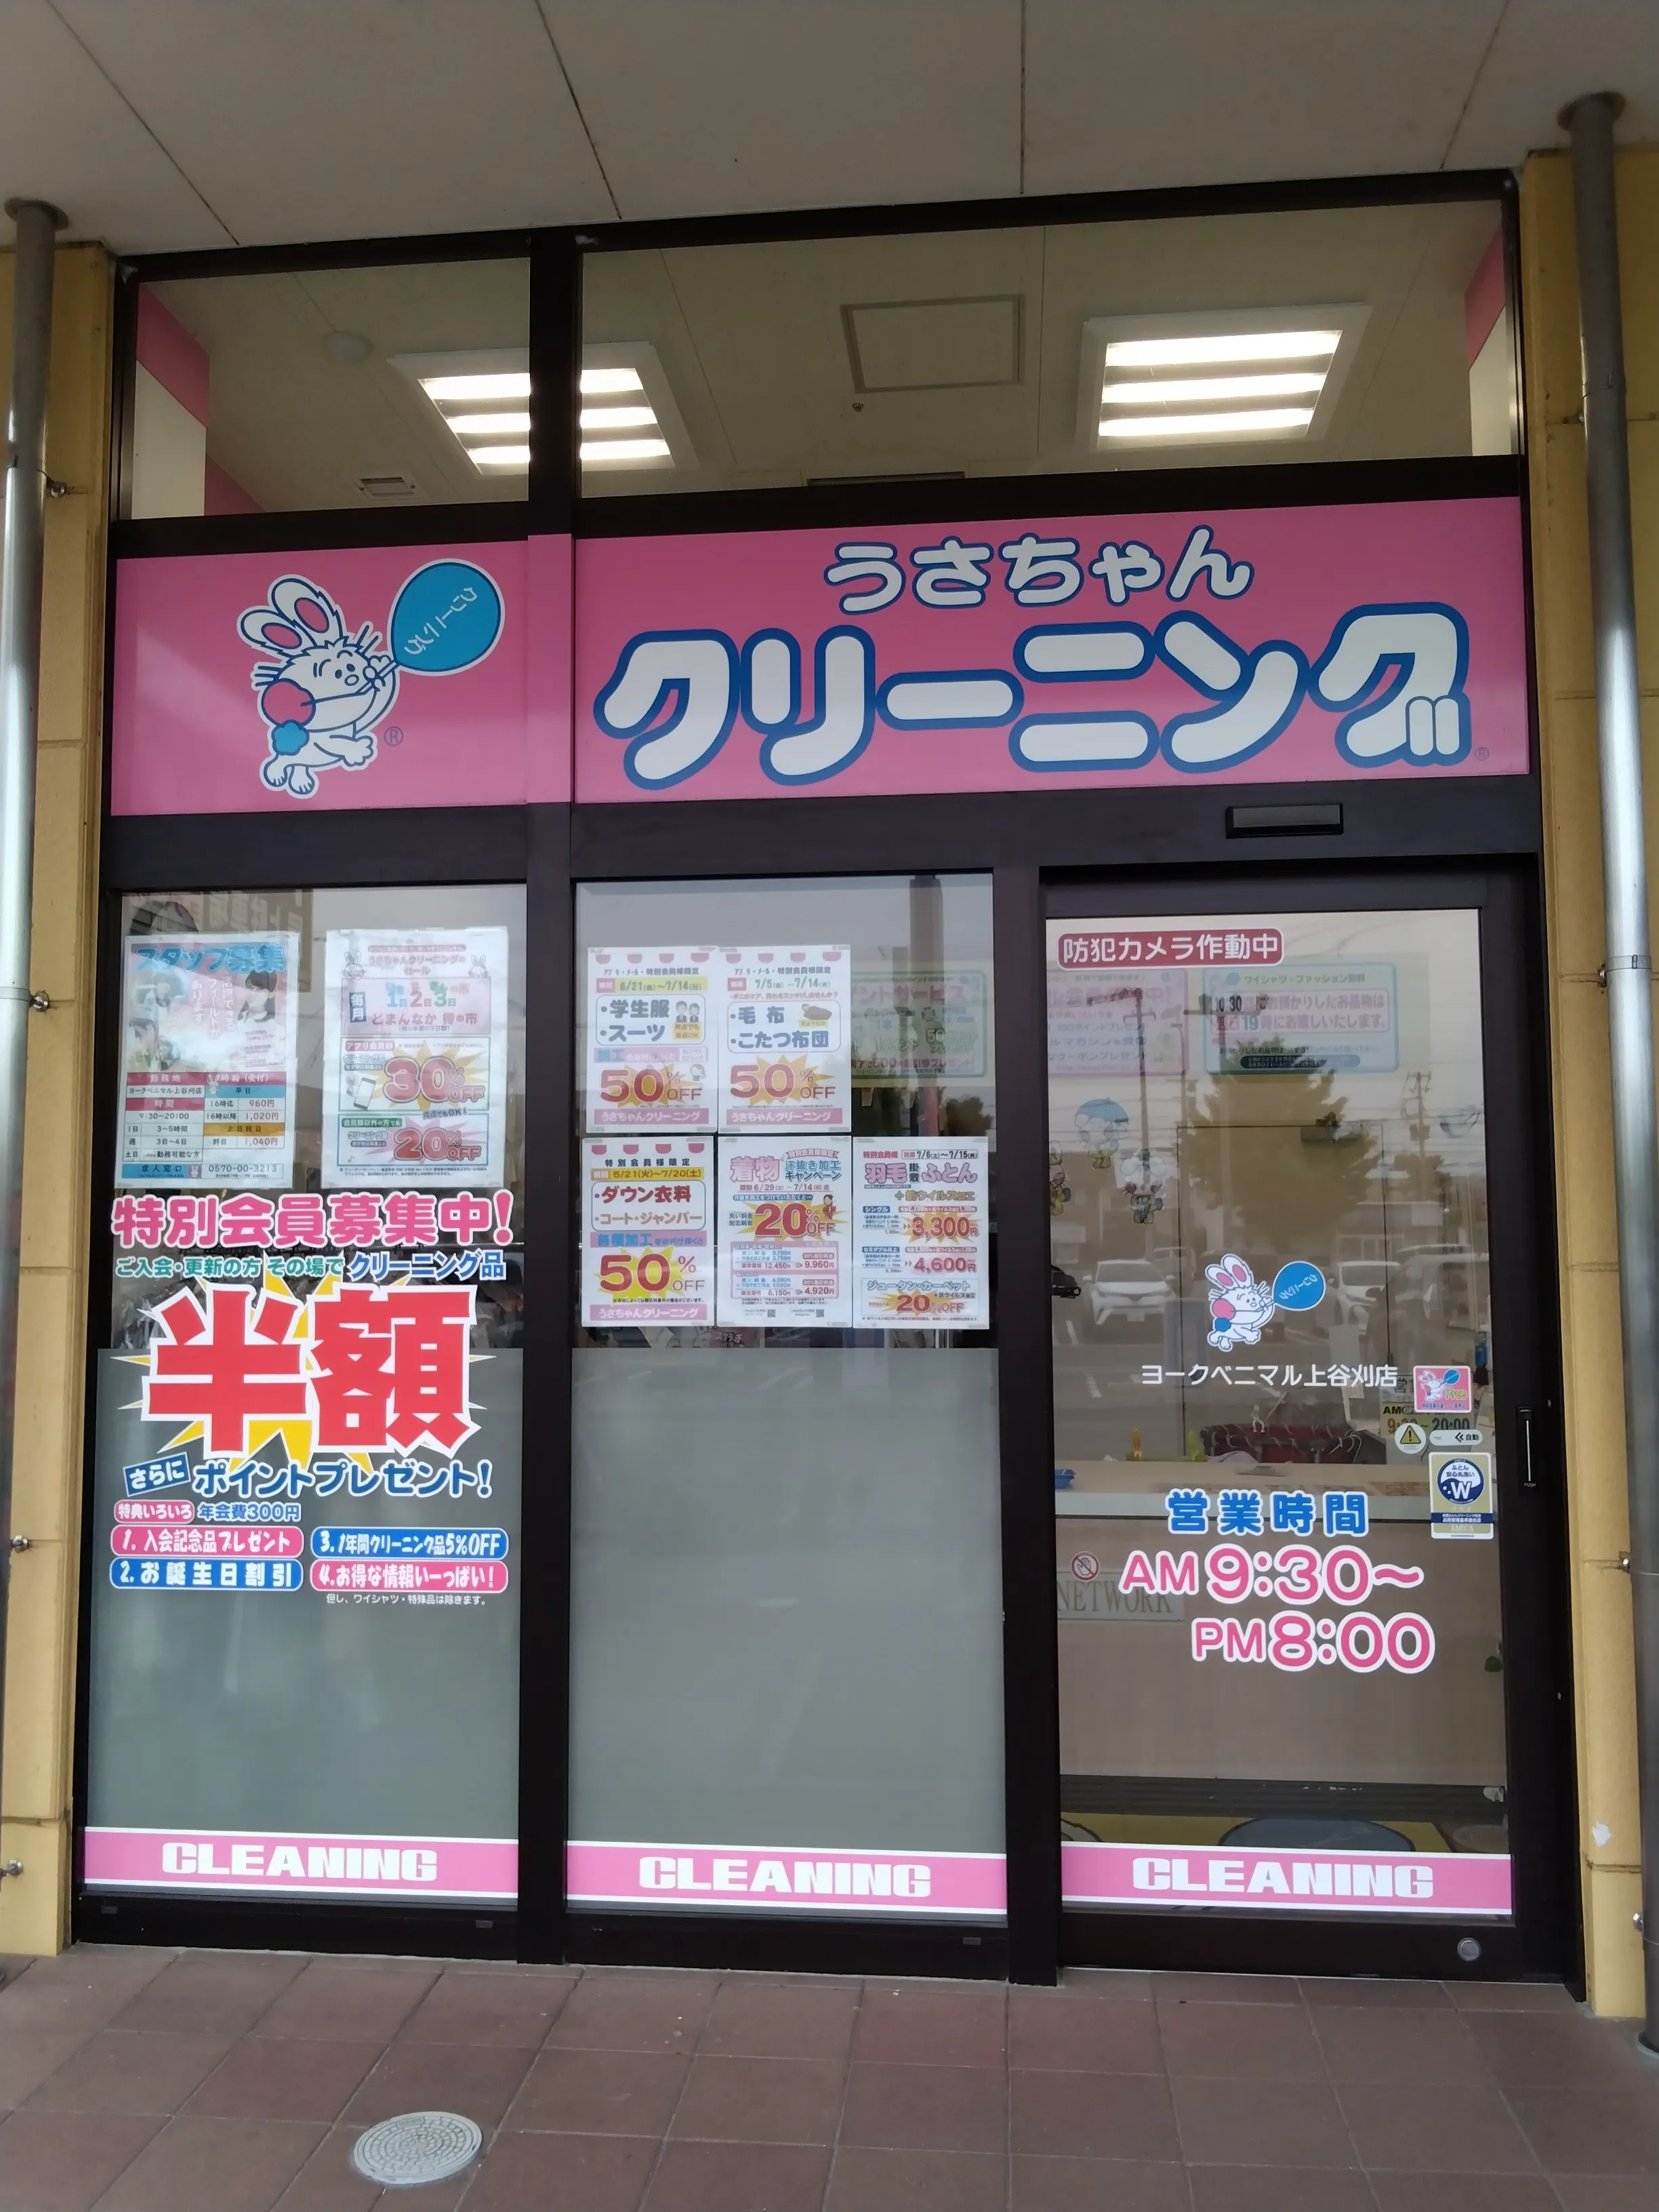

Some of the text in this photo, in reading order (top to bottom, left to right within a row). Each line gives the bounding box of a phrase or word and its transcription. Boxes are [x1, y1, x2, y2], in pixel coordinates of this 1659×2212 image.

[823, 526, 1254, 613] うさちゃん
[405, 587, 477, 655] クリーニング
[594, 601, 1471, 791] クリーニング
[1064, 933, 1279, 964] 防犯カメラ作動中
[136, 943, 287, 973] スタッフ募集
[150, 1074, 181, 1083] 勤務地
[129, 1087, 202, 1095] ヨークベニマル上谷刈店
[448, 1086, 485, 1103] OFF
[667, 1088, 702, 1101] OFF
[800, 1086, 836, 1099] OFF
[155, 1100, 174, 1108] 時間
[249, 1100, 274, 1108] 960円
[206, 1112, 237, 1120] 16時以降
[246, 1111, 279, 1121] 1,020円
[601, 1111, 700, 1122] うさちゃんクリーニング
[731, 1111, 832, 1122] うさちゃんクリーニング
[245, 1137, 278, 1146] 1,040円
[125, 1150, 138, 1158] 土日
[447, 1146, 482, 1161] OFF
[209, 1164, 277, 1173] 0570-00-3213
[605, 1158, 690, 1167] 特別会員様限定
[730, 1155, 779, 1183] 着物
[785, 1171, 842, 1181] キャンペーン
[865, 1163, 907, 1184] 羽毛
[921, 1162, 978, 1183] ふとん
[112, 1189, 514, 1248] 特別会員募集中!
[807, 1223, 835, 1235] OFF
[116, 1250, 506, 1281] ご入会・更新の方 その場で クリーニング品
[804, 1261, 834, 1269] 9,960円
[672, 1280, 705, 1291] OFF
[867, 1280, 970, 1291] ジュータン・カーペット
[598, 1308, 699, 1318] うさちゃんクリーニング
[140, 1283, 481, 1458] 半額
[1141, 1364, 1397, 1388] ヨークベニマル上谷刈店
[1445, 1388, 1467, 1399] Free
[127, 1459, 493, 1497] さらに ポイントプレゼント!
[117, 1502, 302, 1521] 特典いろいろ 年会費300円
[1166, 1488, 1369, 1536] 営業時間
[161, 1841, 438, 1882] CLEANING
[638, 1856, 931, 1898] CLEANING
[1133, 1857, 1433, 1898] CLEANING
